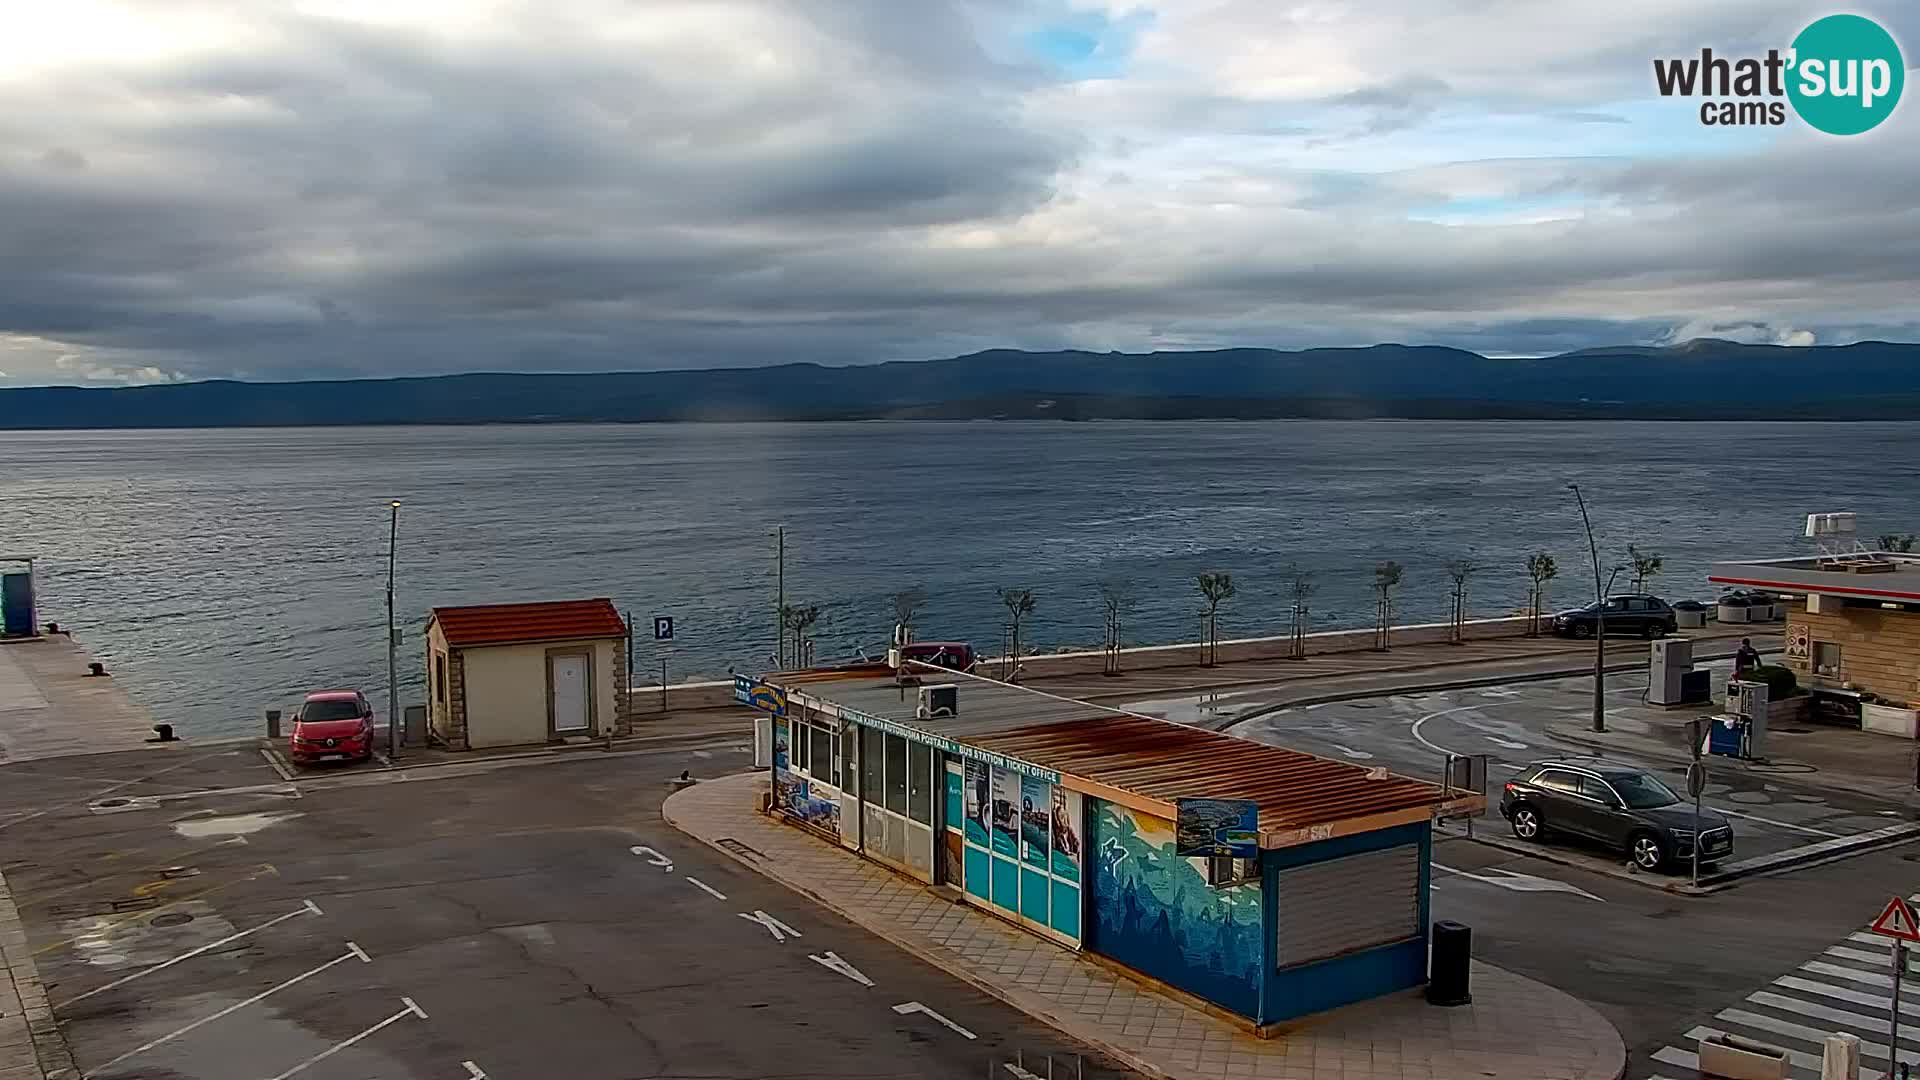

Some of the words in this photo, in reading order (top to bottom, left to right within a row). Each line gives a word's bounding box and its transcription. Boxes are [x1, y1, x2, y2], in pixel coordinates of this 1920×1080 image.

[659, 620, 669, 637] P
[921, 732, 950, 751] POSTAJA
[959, 744, 973, 759] BUS
[973, 748, 1004, 768] STATION
[1006, 758, 1030, 775] TICKET
[1031, 766, 1057, 783] OFFICE
